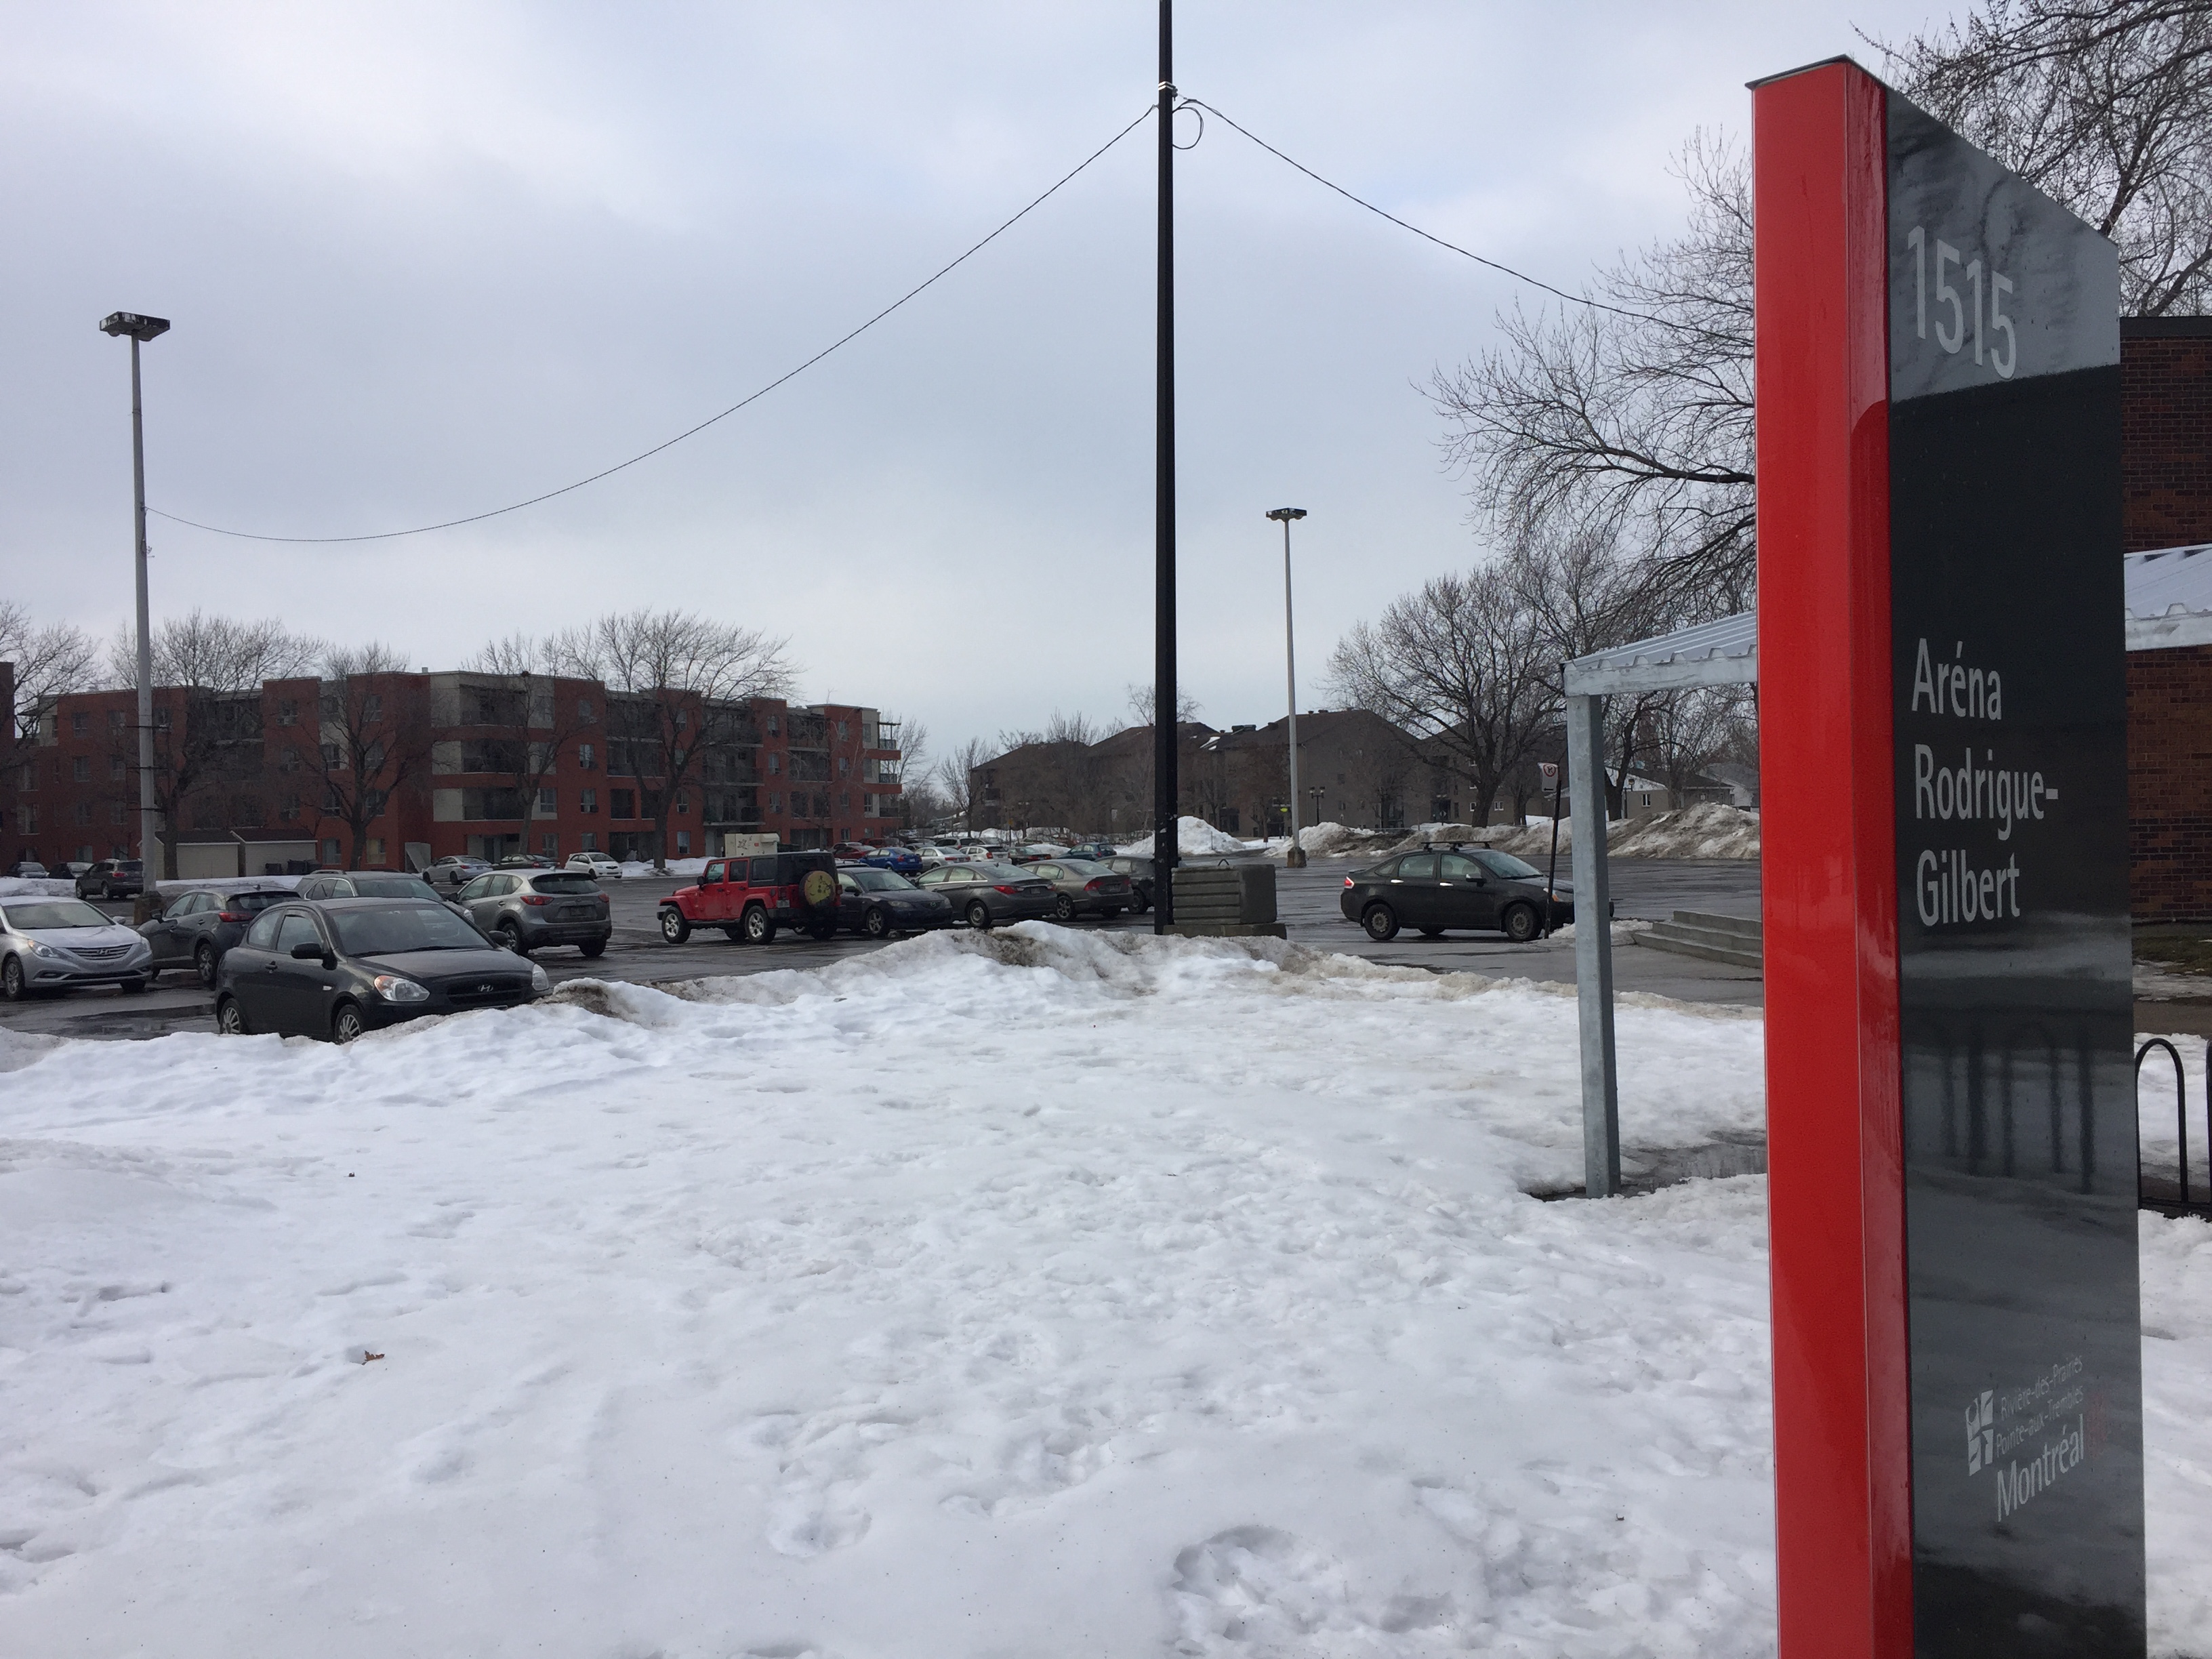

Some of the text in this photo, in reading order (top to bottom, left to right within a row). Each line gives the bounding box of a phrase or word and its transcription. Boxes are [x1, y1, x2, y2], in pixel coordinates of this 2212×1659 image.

[1908, 225, 2017, 381] 1515
[1912, 638, 2001, 720] Aréna
[1915, 743, 2059, 840] Rodrigue-
[1917, 849, 2020, 926] Gilbert
[1997, 1413, 2084, 1522] Montréal
